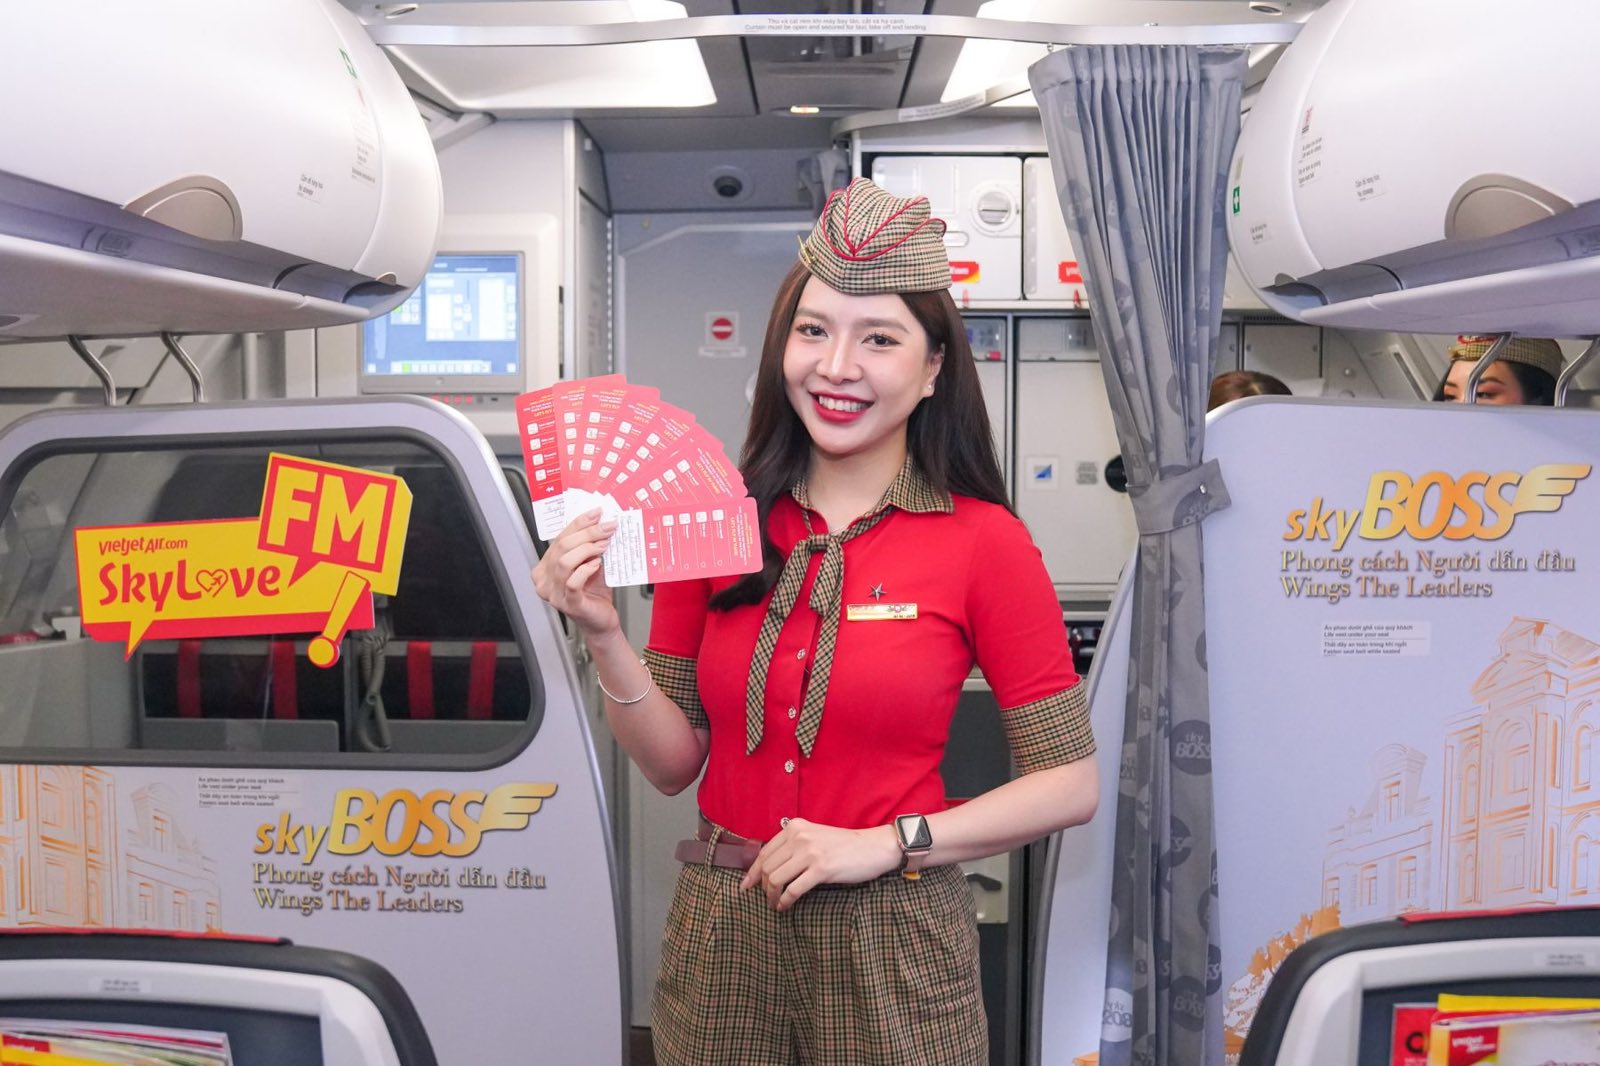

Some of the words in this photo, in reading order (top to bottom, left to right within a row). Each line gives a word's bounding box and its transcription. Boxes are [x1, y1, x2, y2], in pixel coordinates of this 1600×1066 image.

[266, 465, 388, 564] FM
[1280, 550, 1353, 578] Phong
[1359, 550, 1409, 572] cách
[1416, 550, 1481, 578] Người
[1280, 576, 1351, 605] Wings
[1355, 576, 1399, 598] The
[1406, 576, 1493, 598] Leaders
[253, 863, 324, 892] Phong
[330, 865, 379, 886] cách
[385, 865, 450, 893] Người
[253, 888, 323, 917] Wings
[327, 889, 370, 911] The
[376, 891, 464, 913] Leaders
